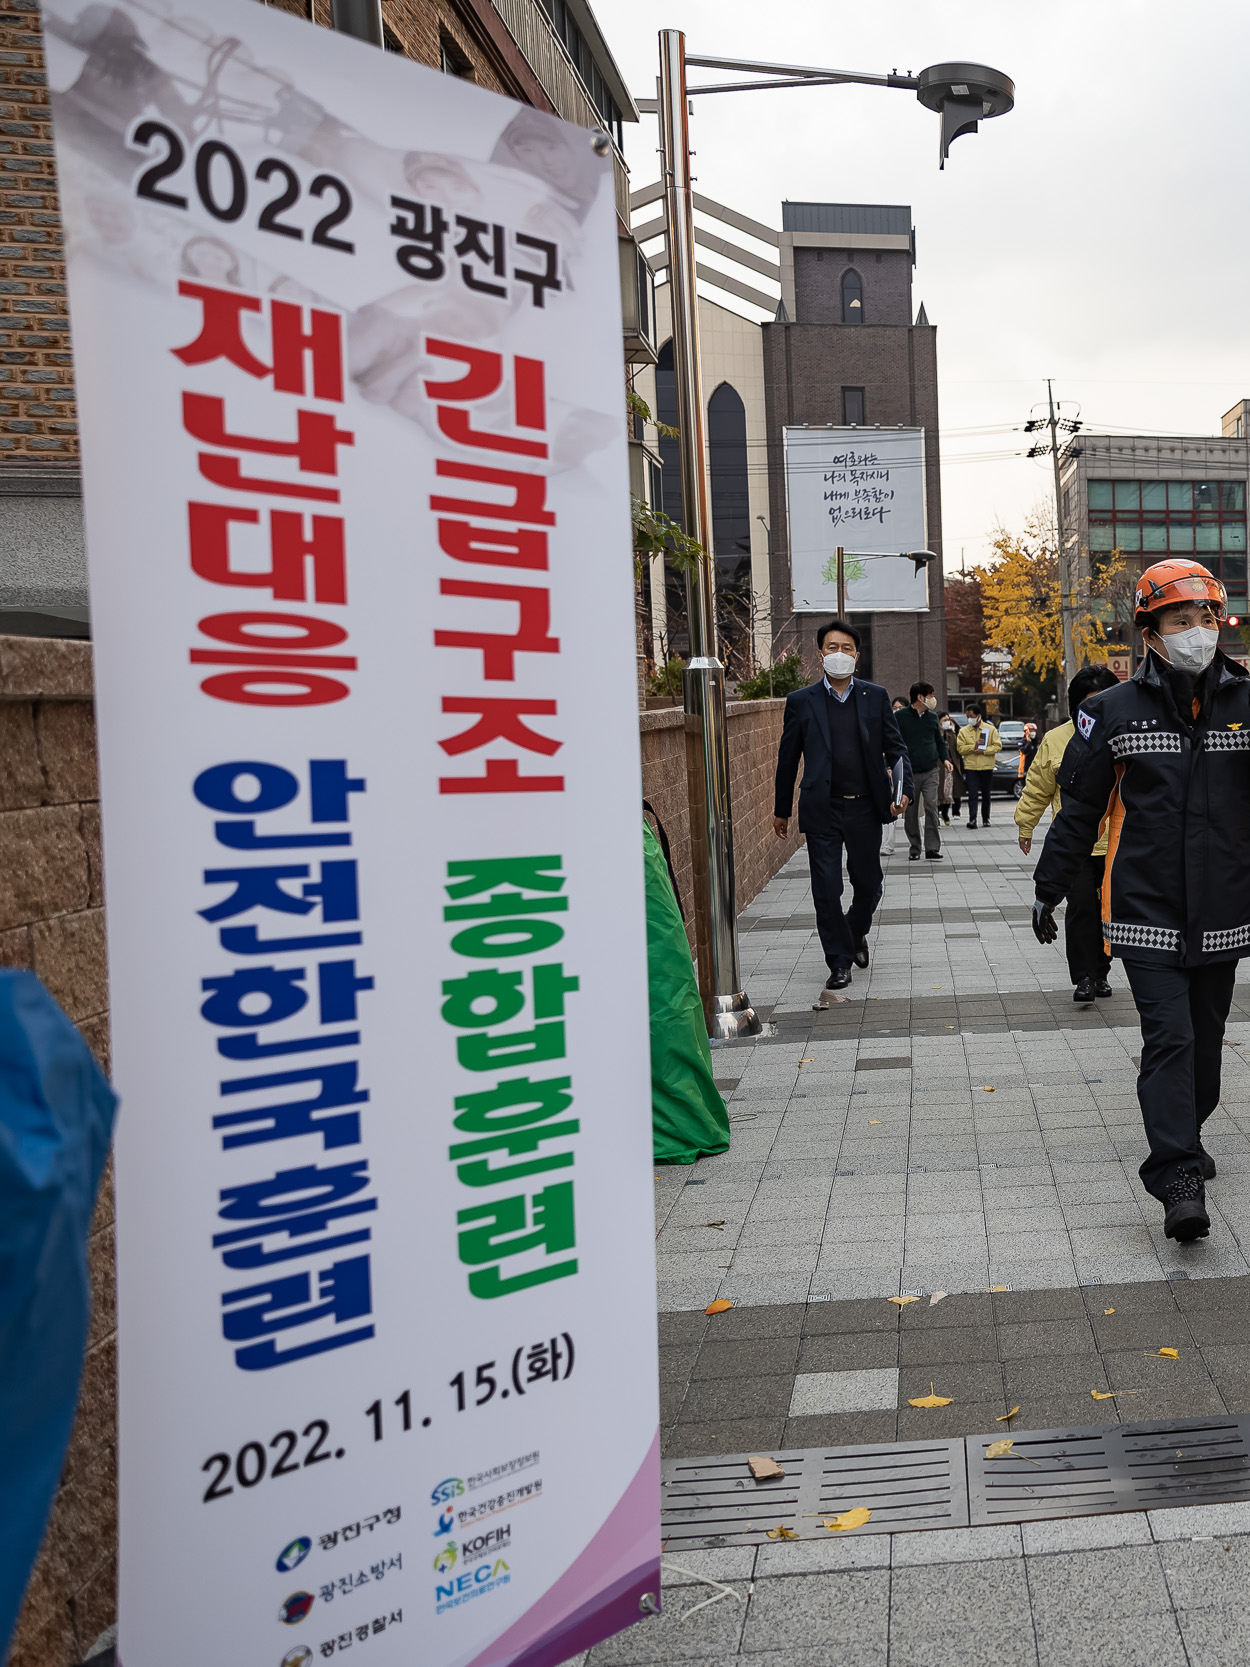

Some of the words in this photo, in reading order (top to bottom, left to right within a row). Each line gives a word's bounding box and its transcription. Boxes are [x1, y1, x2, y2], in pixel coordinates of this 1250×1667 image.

[132, 120, 356, 255] 2022
[390, 194, 563, 309] 광진구
[824, 470, 846, 484] 나의
[849, 469, 889, 486] 목자시니
[833, 451, 878, 468] 여호와는
[170, 279, 358, 708] 재난대응
[824, 490, 850, 501] 내게
[851, 487, 895, 504] 부족함이
[829, 505, 891, 527] 없으리로다
[422, 337, 565, 795] 긴급구조
[441, 854, 580, 1301] 종합훈련
[202, 1419, 346, 1504] 2022.
[364, 1390, 432, 1442] 11.
[448, 1332, 576, 1413] 15.(화)
[458, 1478, 543, 1523] 한국건강증진개발원
[317, 1505, 402, 1551] 광진구청
[461, 1523, 511, 1557] KOFIH
[318, 1552, 403, 1603] 광진소방서
[319, 1608, 403, 1659] 광진경찰서
